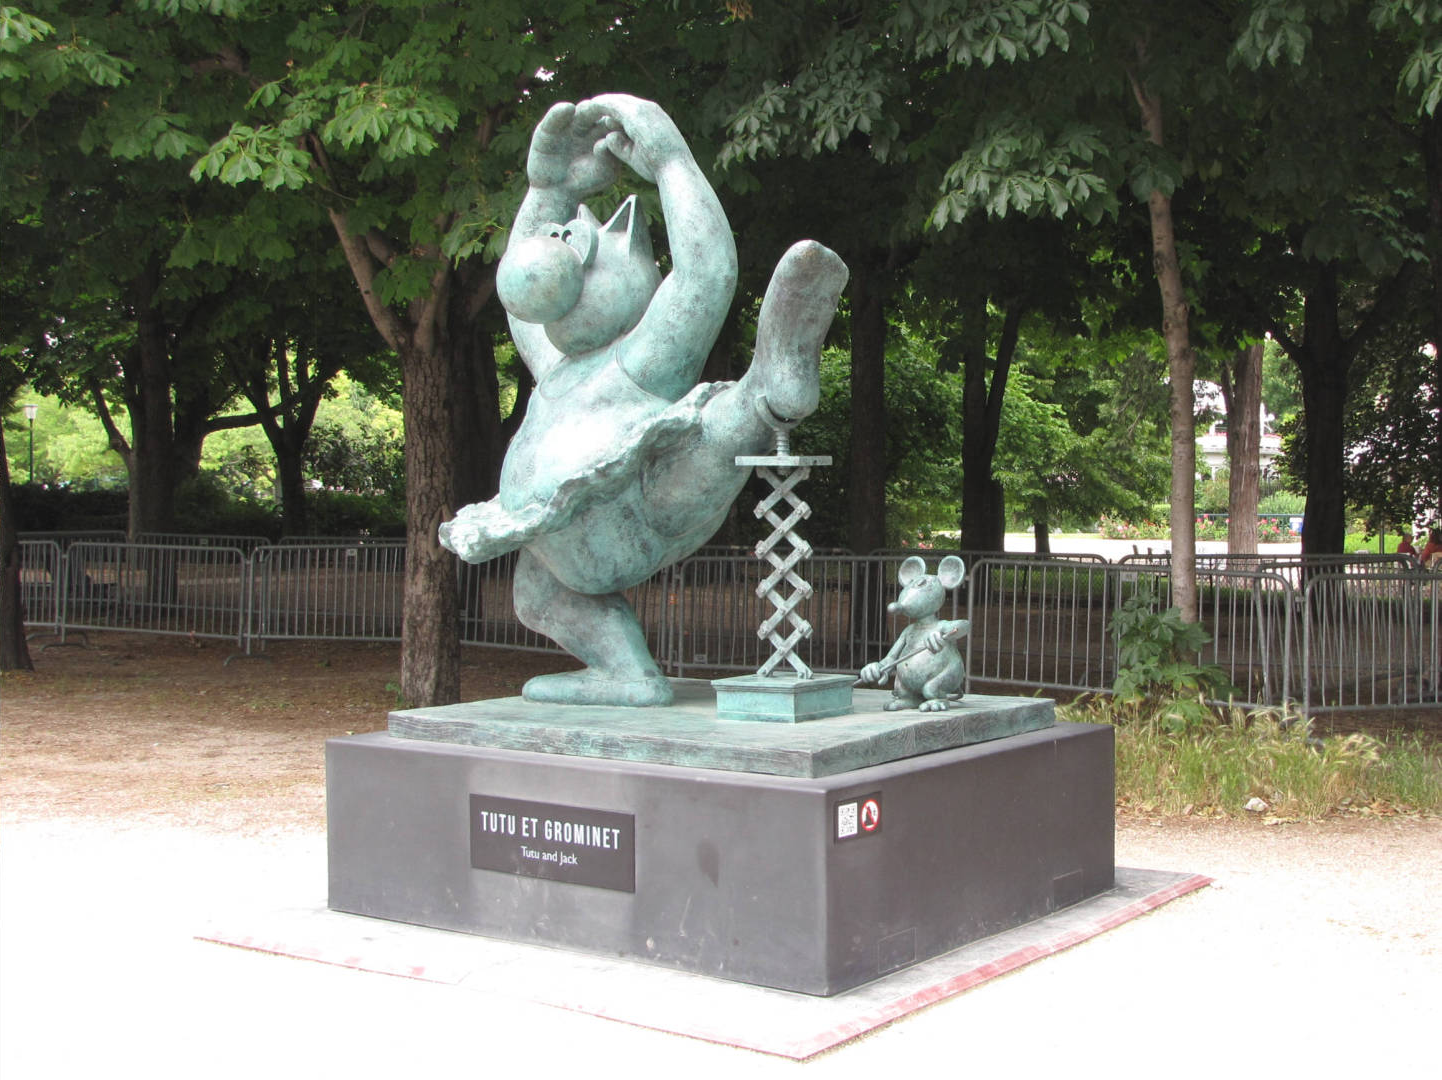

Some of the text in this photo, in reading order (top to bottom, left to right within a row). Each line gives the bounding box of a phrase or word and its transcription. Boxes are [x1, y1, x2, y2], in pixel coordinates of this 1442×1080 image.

[481, 811, 620, 850] TUTU ET GROMINET
[521, 846, 578, 866] Tutu and Jack
